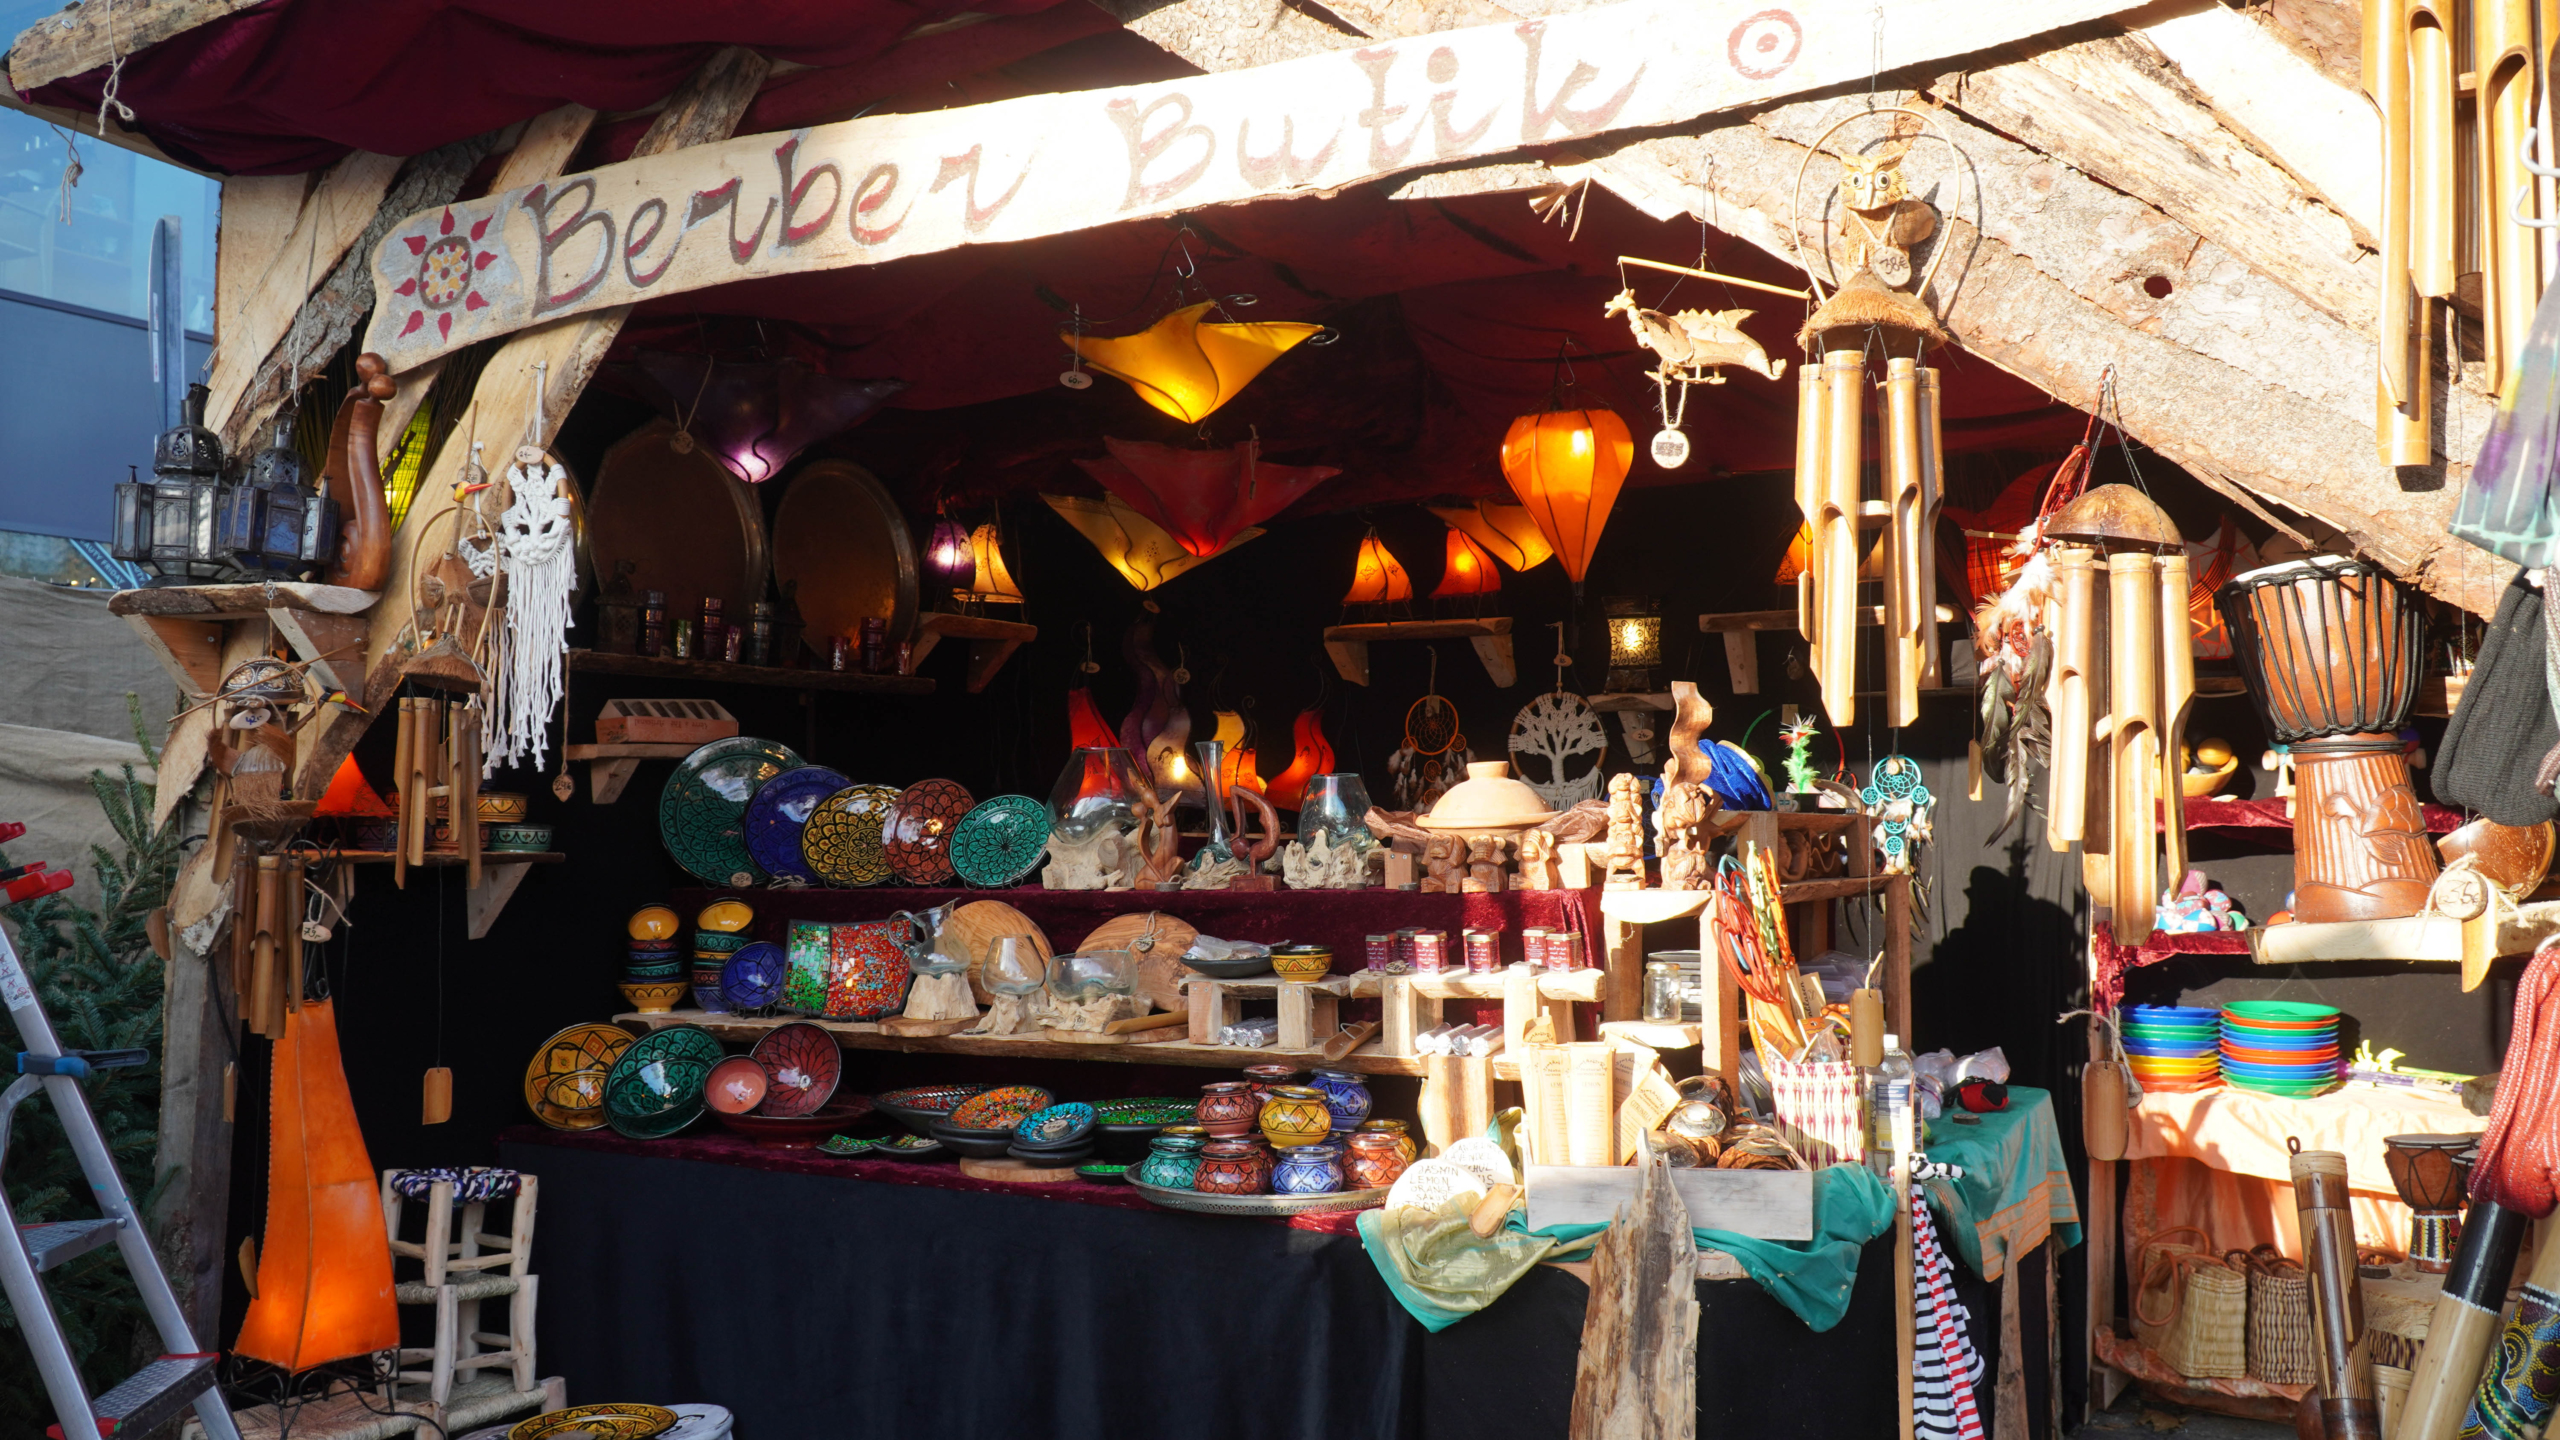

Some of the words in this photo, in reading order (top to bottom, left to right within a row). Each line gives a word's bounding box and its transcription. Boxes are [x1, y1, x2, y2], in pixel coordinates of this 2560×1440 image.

[520, 128, 1042, 318] Berber
[1104, 20, 1648, 213] Butik
[1417, 1165, 1459, 1177] JASMIN
[1409, 1174, 1449, 1185] LEMON
